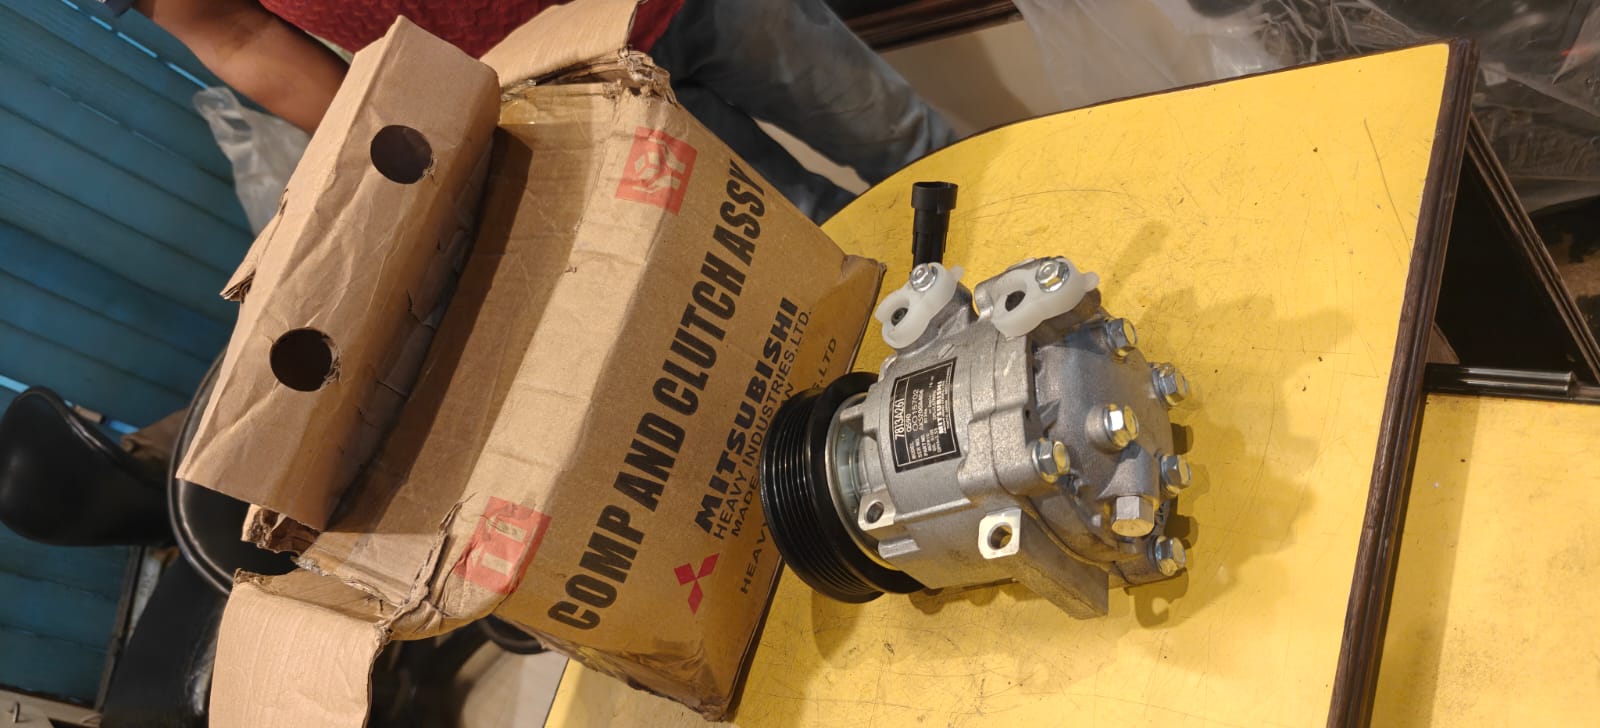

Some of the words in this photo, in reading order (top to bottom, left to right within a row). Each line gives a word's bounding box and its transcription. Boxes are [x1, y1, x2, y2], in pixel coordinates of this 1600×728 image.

[547, 504, 645, 630] COMP
[613, 412, 686, 512] AND
[652, 251, 746, 416] CLUTCH
[712, 158, 765, 266] ASSY
[695, 297, 798, 534] MITSUBISHI
[894, 398, 905, 440] 7813A261
[713, 470, 748, 540] HEAVY
[731, 477, 759, 537] MADE
